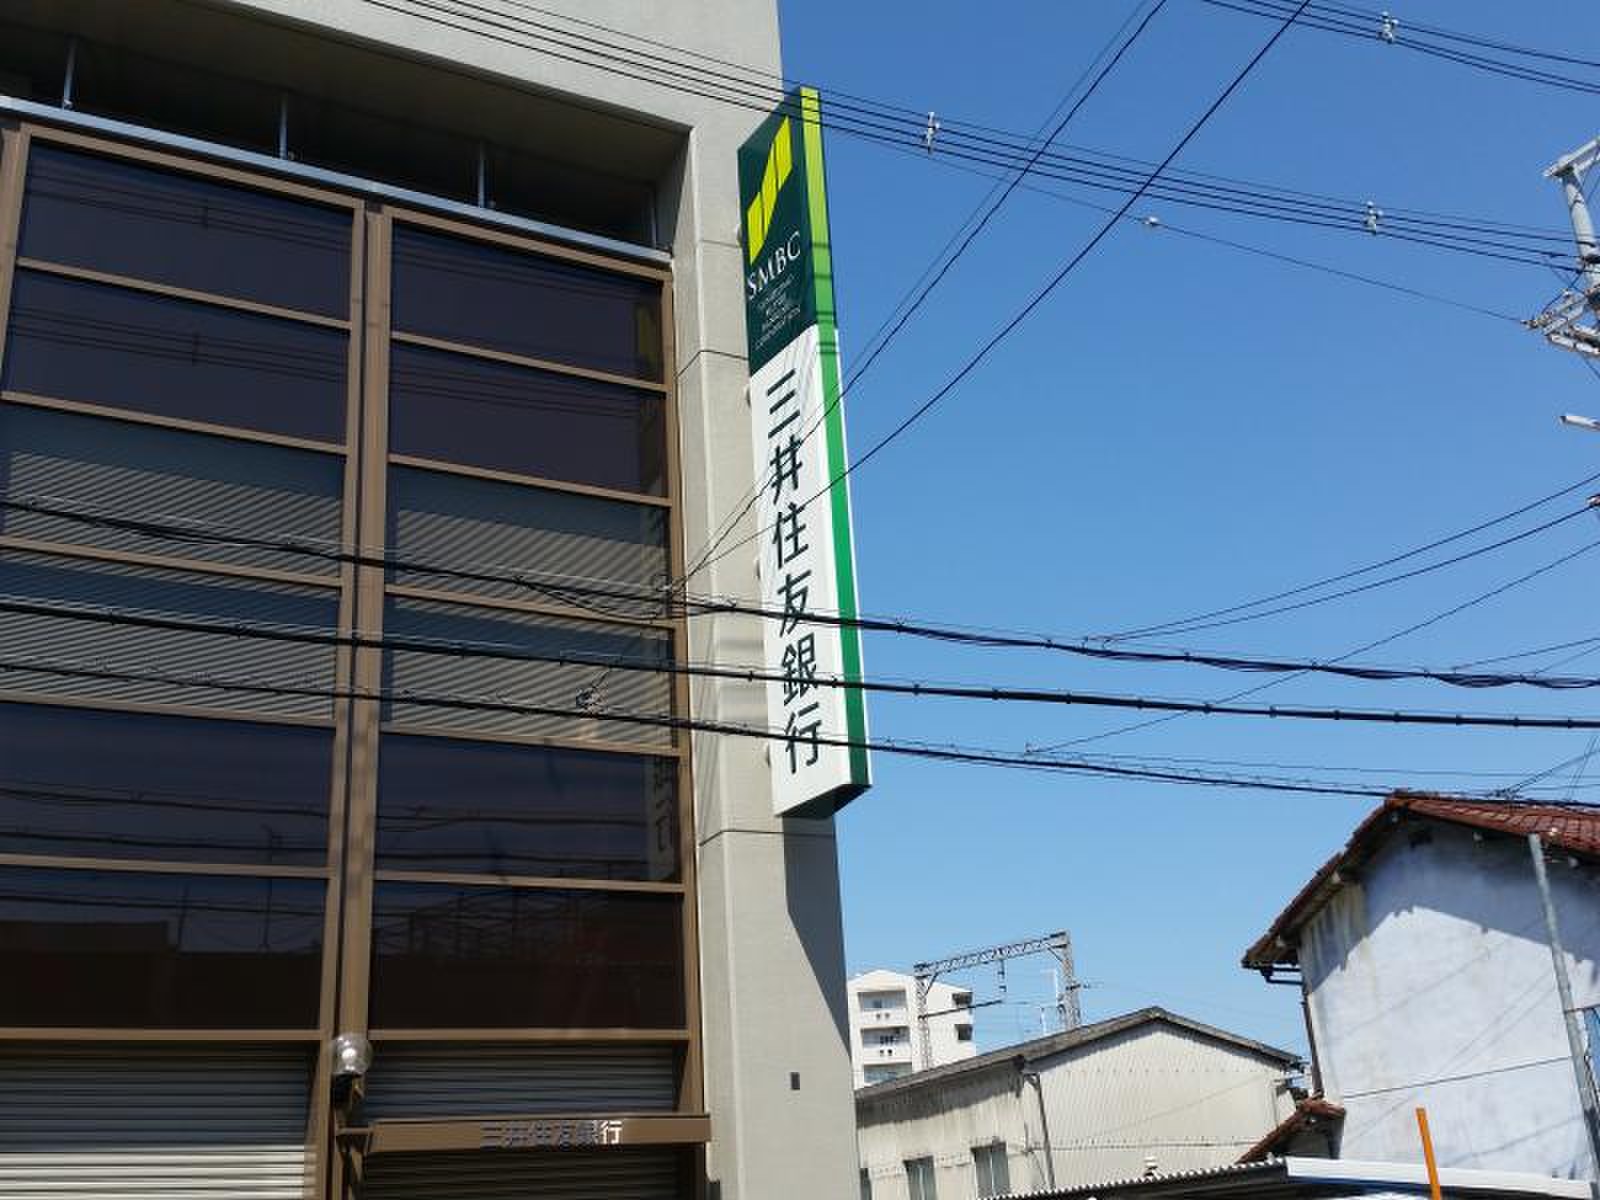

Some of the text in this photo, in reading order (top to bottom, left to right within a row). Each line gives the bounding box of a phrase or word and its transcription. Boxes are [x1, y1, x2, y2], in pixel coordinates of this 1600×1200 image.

[747, 230, 801, 300] SMBC
[767, 369, 822, 774] 三井住友銀行
